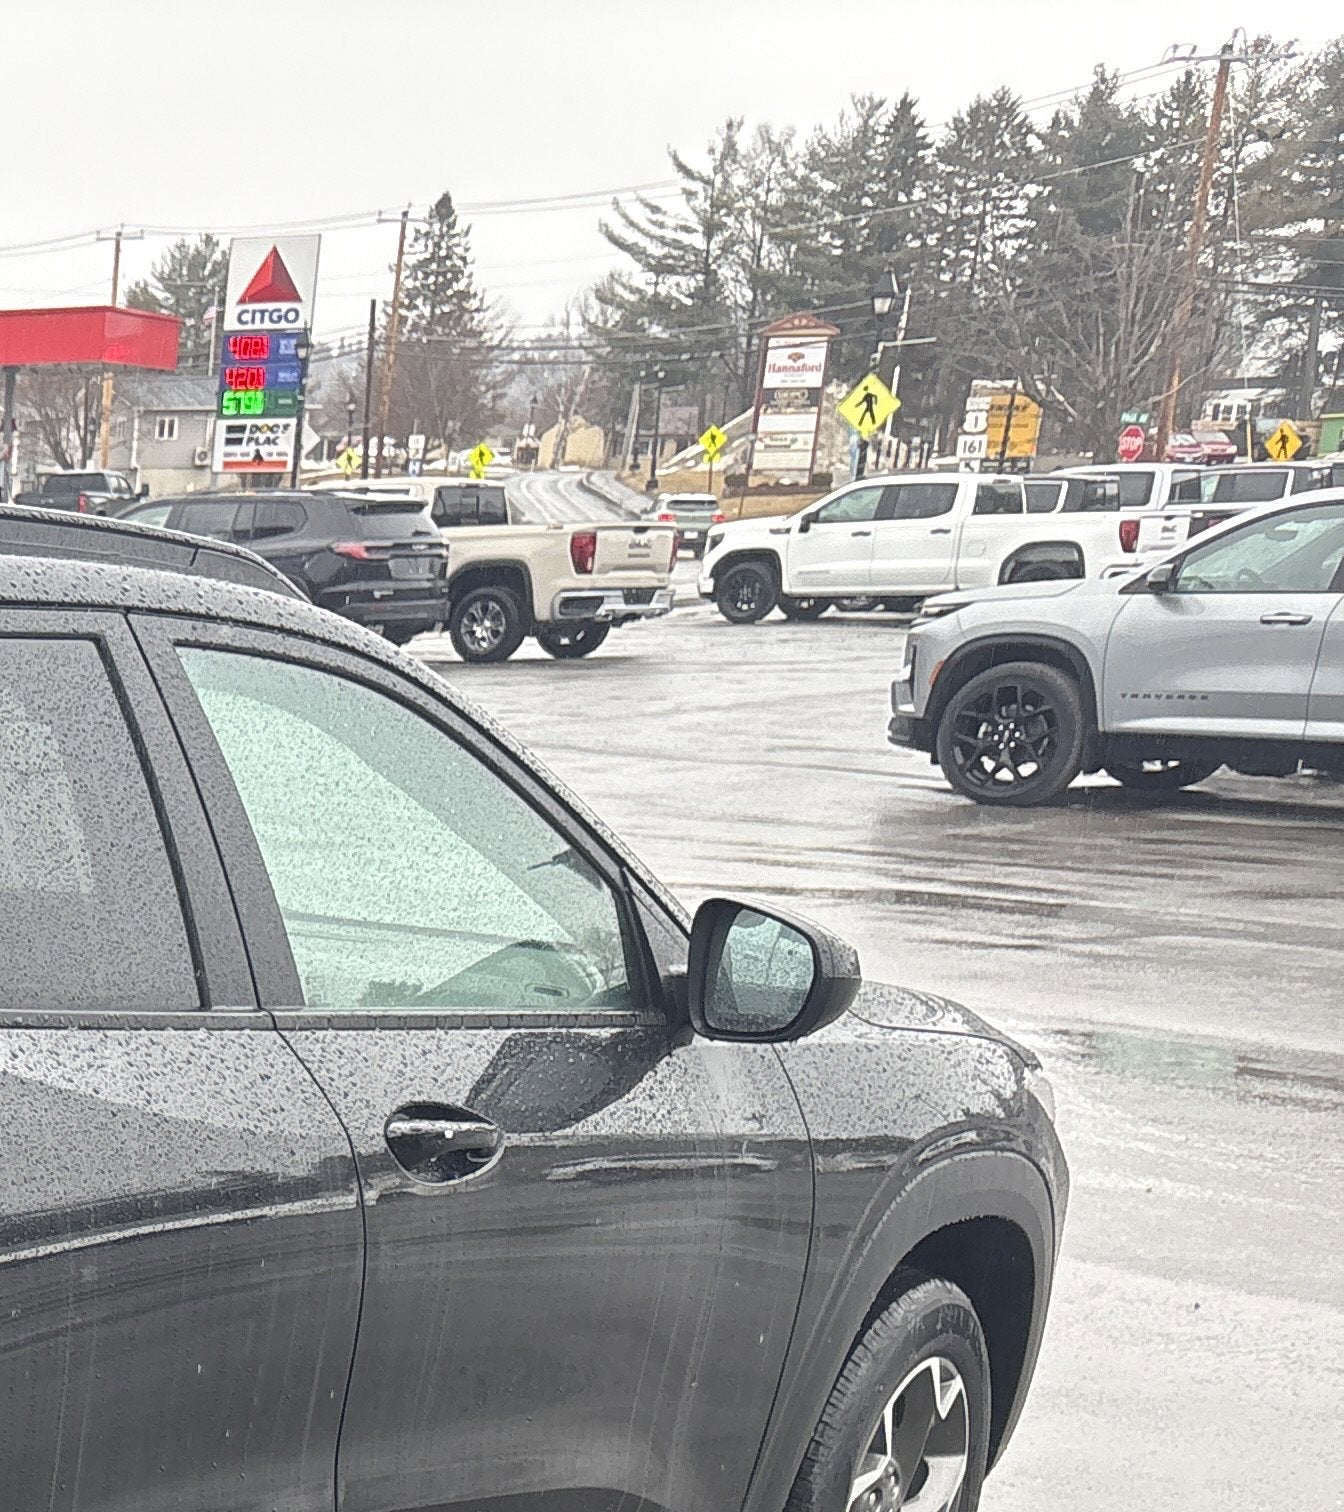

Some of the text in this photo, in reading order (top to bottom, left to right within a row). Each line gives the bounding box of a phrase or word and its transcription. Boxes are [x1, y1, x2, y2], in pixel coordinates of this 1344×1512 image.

[237, 308, 300, 325] CITGO
[768, 362, 822, 373] Hannaford
[963, 440, 983, 454] 161
[1121, 436, 1142, 451] STOP
